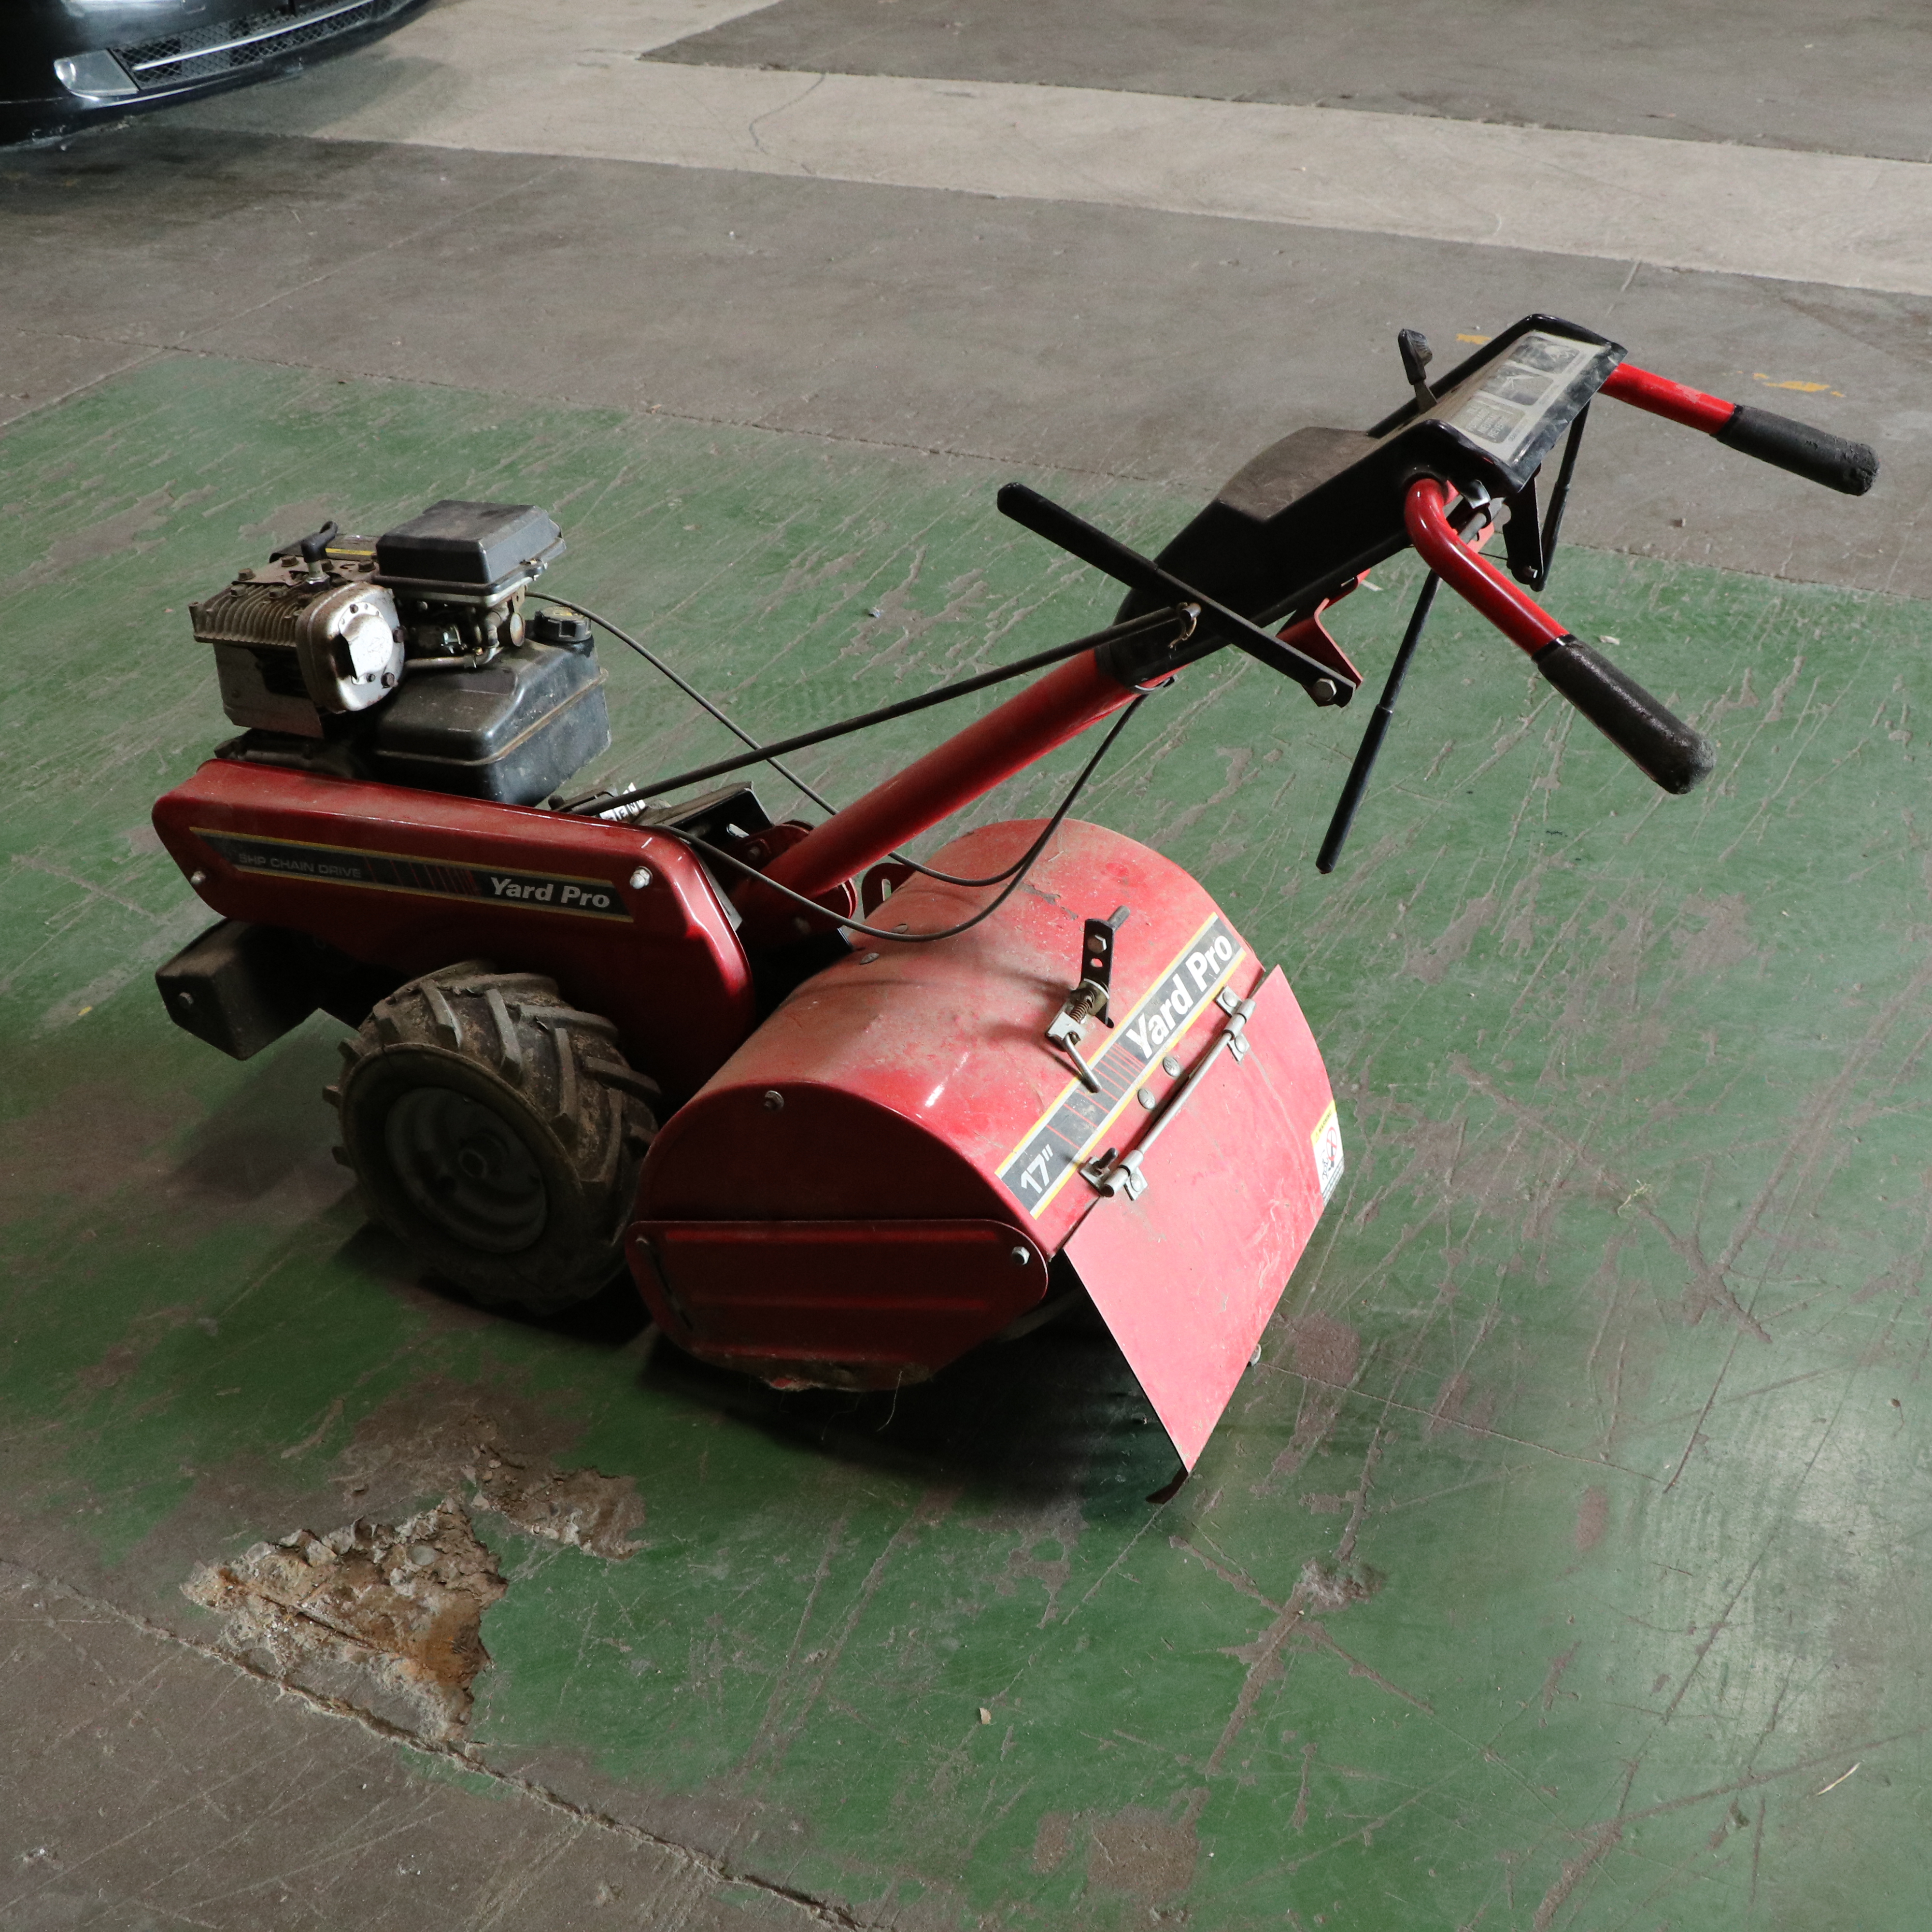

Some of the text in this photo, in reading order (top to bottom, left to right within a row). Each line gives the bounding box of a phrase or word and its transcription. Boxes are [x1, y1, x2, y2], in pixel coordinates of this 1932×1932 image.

[270, 858, 314, 873] CHAIN
[318, 864, 361, 879] DRIVE
[491, 877, 610, 908] Yard Pro
[1125, 935, 1232, 1060] Yard Pro
